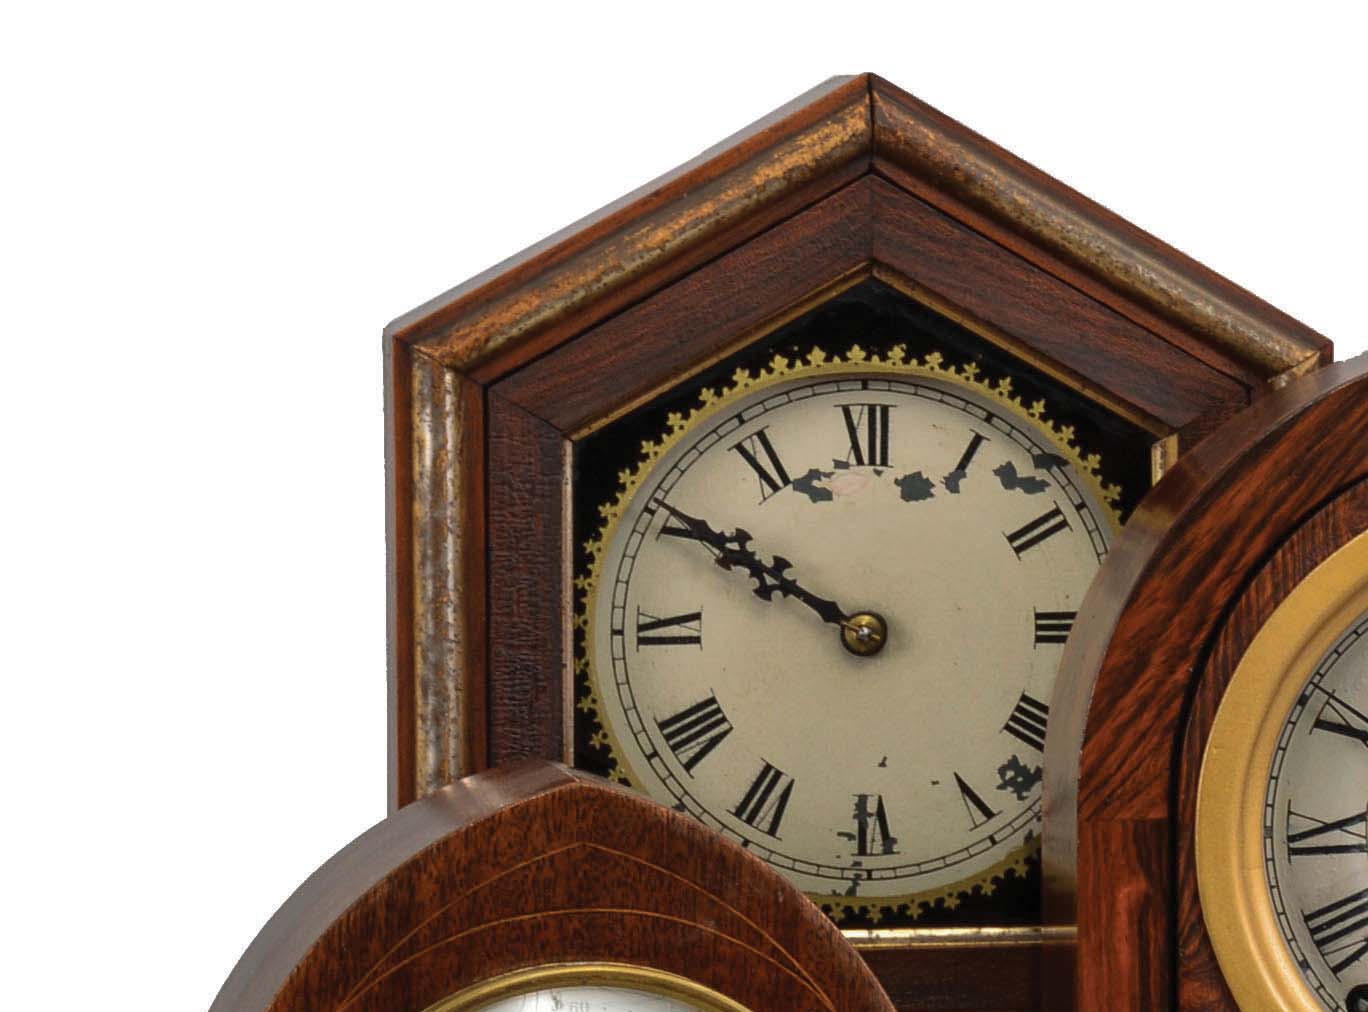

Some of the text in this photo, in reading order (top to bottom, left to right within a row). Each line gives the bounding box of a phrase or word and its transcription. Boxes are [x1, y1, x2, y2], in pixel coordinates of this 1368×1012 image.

[729, 426, 792, 504] XI
[834, 404, 898, 467] XII
[1003, 501, 1073, 560] II
[636, 606, 702, 651] IX
[654, 689, 733, 778] VIII
[727, 758, 793, 840] VII
[852, 794, 900, 856] VI
[954, 772, 1002, 831] V
